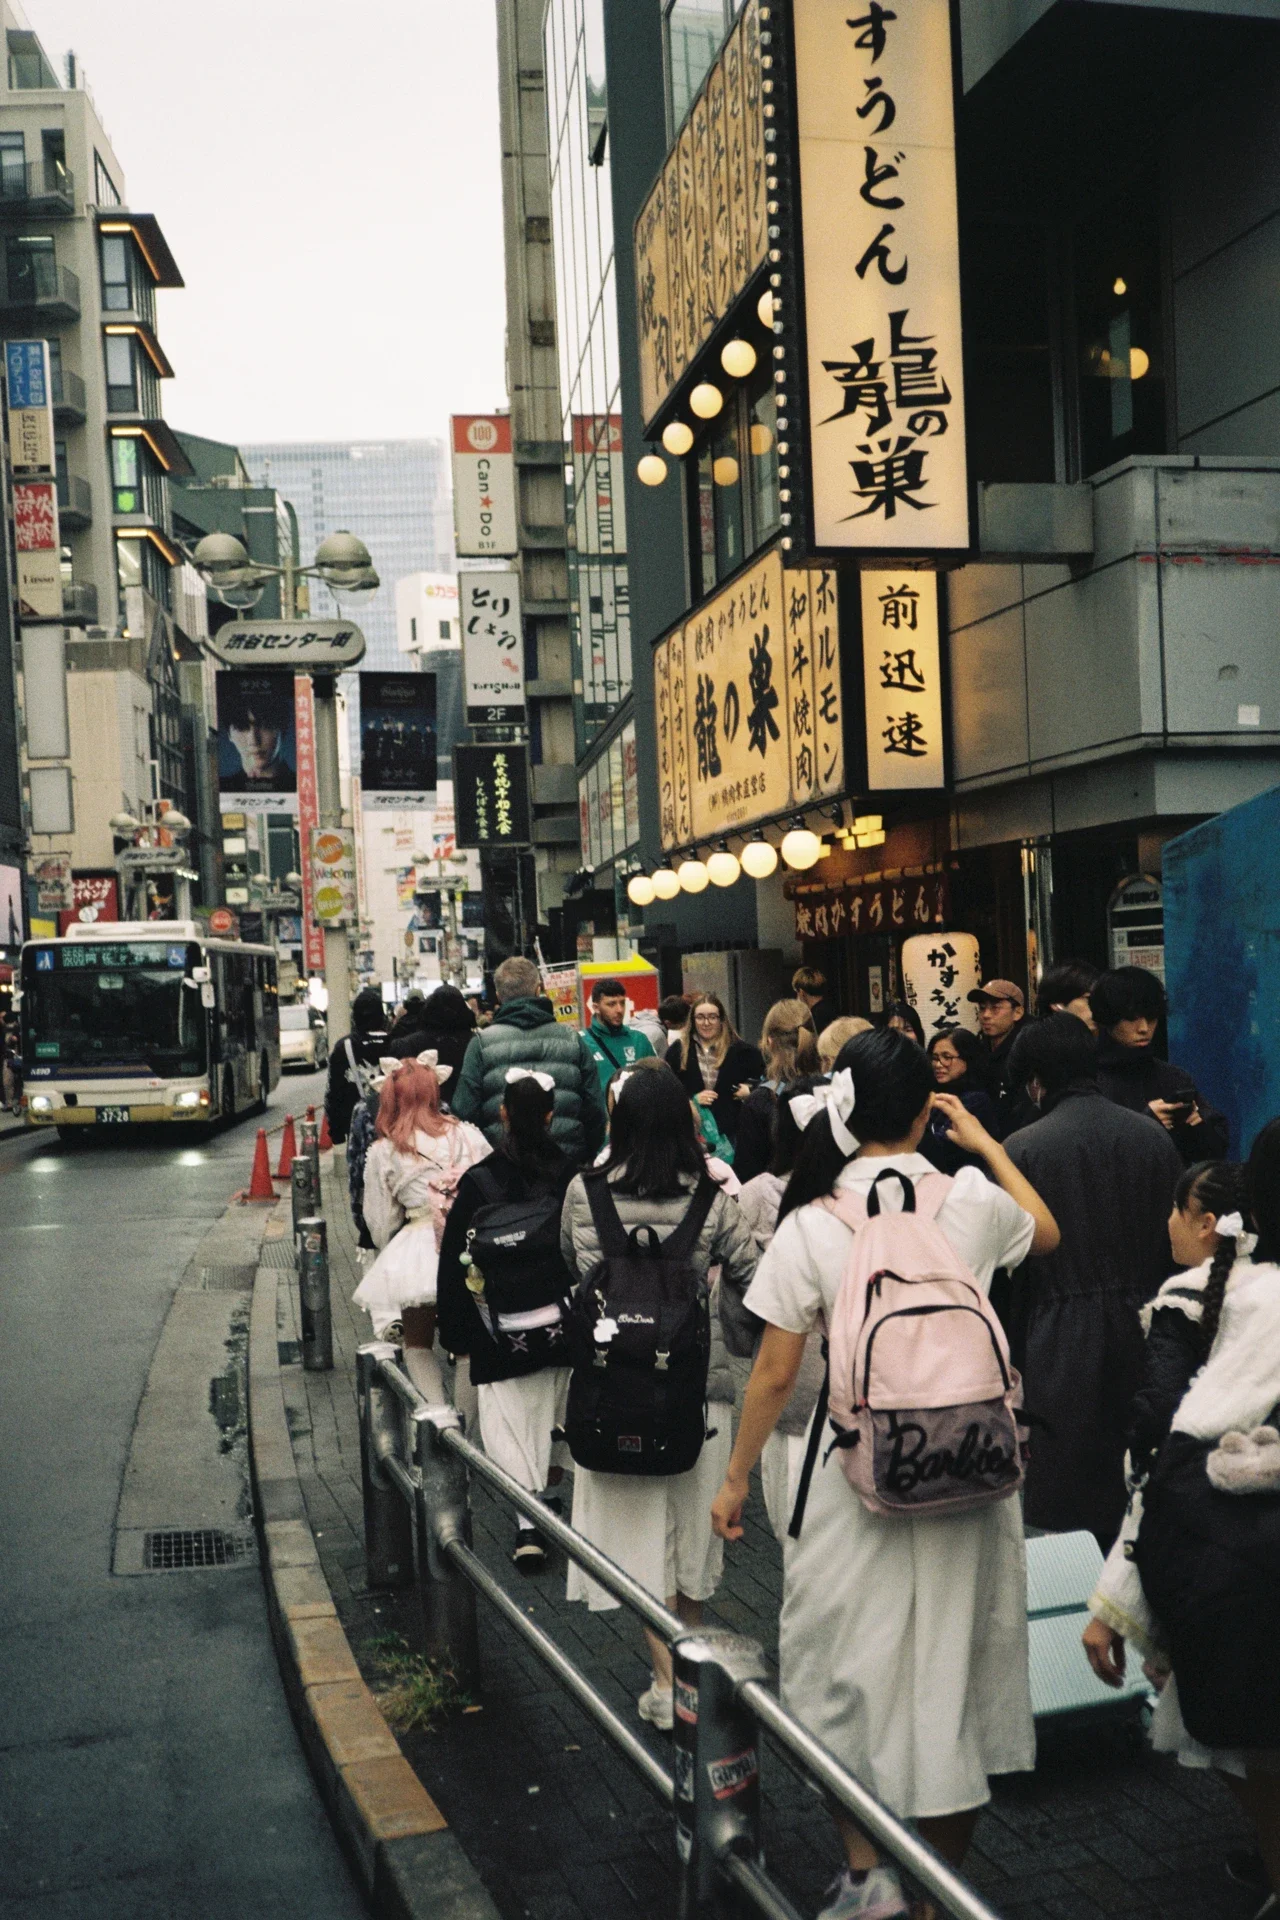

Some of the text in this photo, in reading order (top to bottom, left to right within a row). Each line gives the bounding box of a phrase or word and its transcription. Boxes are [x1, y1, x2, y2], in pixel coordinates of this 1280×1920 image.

[846, 1, 908, 285] すうどん
[816, 308, 953, 524] 龍の巣
[224, 631, 354, 651] 渋谷センター街
[487, 708, 507, 722] 2F
[789, 586, 812, 791] 和牛焼肉
[816, 570, 839, 784] ホルモン
[878, 583, 928, 758] 前迅速
[927, 942, 962, 1028] かすうどん
[886, 1420, 1021, 1492] Barbie
